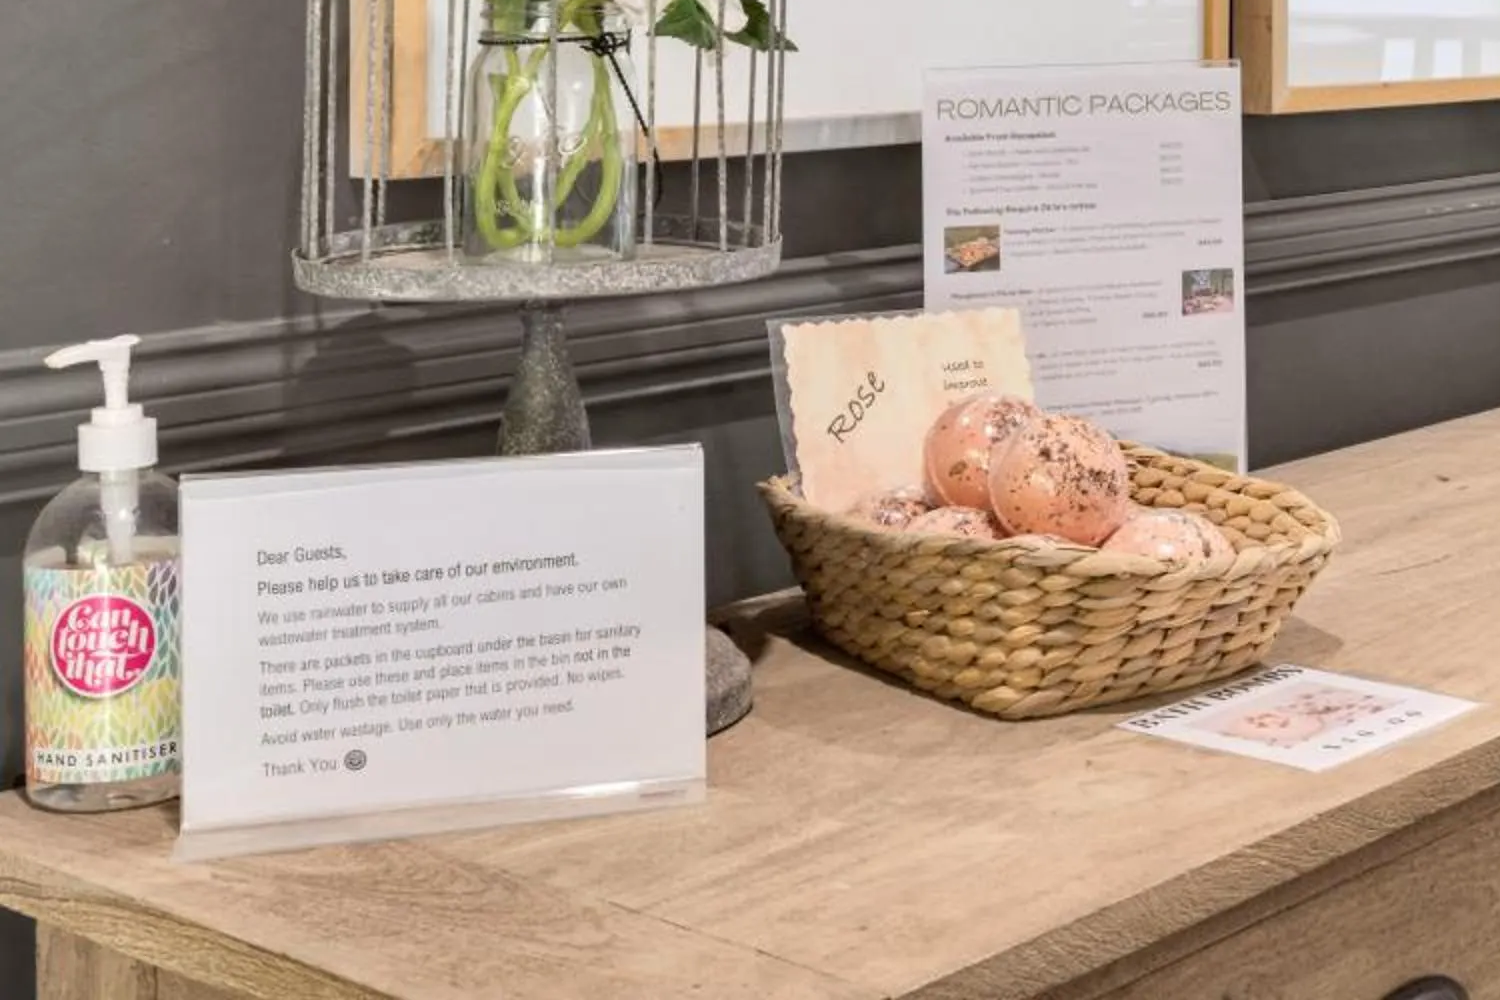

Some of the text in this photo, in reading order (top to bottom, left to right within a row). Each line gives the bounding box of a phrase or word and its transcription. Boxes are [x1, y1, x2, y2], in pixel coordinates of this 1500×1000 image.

[937, 91, 1232, 121] ROMANTIC PACKAGES
[257, 545, 347, 566] Dear Guests,
[257, 552, 579, 596] Please help us to take care of our environment.
[68, 603, 131, 631] Can
[258, 610, 278, 625] We
[283, 611, 306, 624] use
[310, 604, 367, 621] rainwater
[371, 601, 383, 615] to
[389, 596, 429, 614] supply
[452, 594, 471, 606] our
[478, 588, 514, 604] cabins
[519, 584, 541, 600] and
[546, 582, 574, 597] have
[577, 582, 598, 594] our
[601, 577, 627, 590] own
[58, 620, 149, 658] touch
[260, 659, 296, 675] There
[300, 659, 319, 672] are
[325, 652, 372, 671] packets
[375, 650, 387, 663] in
[391, 648, 411, 661] the
[477, 637, 512, 653] under
[517, 634, 535, 648] the
[539, 630, 571, 646] basin
[595, 623, 642, 640] sanitary
[303, 677, 345, 693] Please
[350, 675, 372, 687] use
[375, 670, 409, 685] these
[413, 667, 435, 681] and
[439, 663, 472, 680] place
[476, 658, 509, 674] items
[513, 656, 525, 669] in
[528, 655, 548, 668] the
[551, 652, 571, 666] bin
[574, 649, 593, 663] not
[597, 647, 609, 661] in
[612, 645, 631, 659] the
[299, 699, 330, 716] Only
[333, 694, 365, 711] flush
[367, 692, 388, 707] the
[391, 688, 423, 704] toilet
[426, 684, 460, 701] paper
[465, 680, 487, 696] that
[491, 678, 501, 693] is
[567, 671, 584, 685] No
[261, 731, 298, 746] Avoid
[301, 727, 336, 742] water
[398, 717, 422, 731] Use
[426, 712, 453, 728] only
[457, 710, 477, 725] the
[480, 707, 511, 722] water
[515, 704, 539, 721] you
[36, 741, 178, 768] HAND SANITISER
[263, 760, 305, 777] Thank
